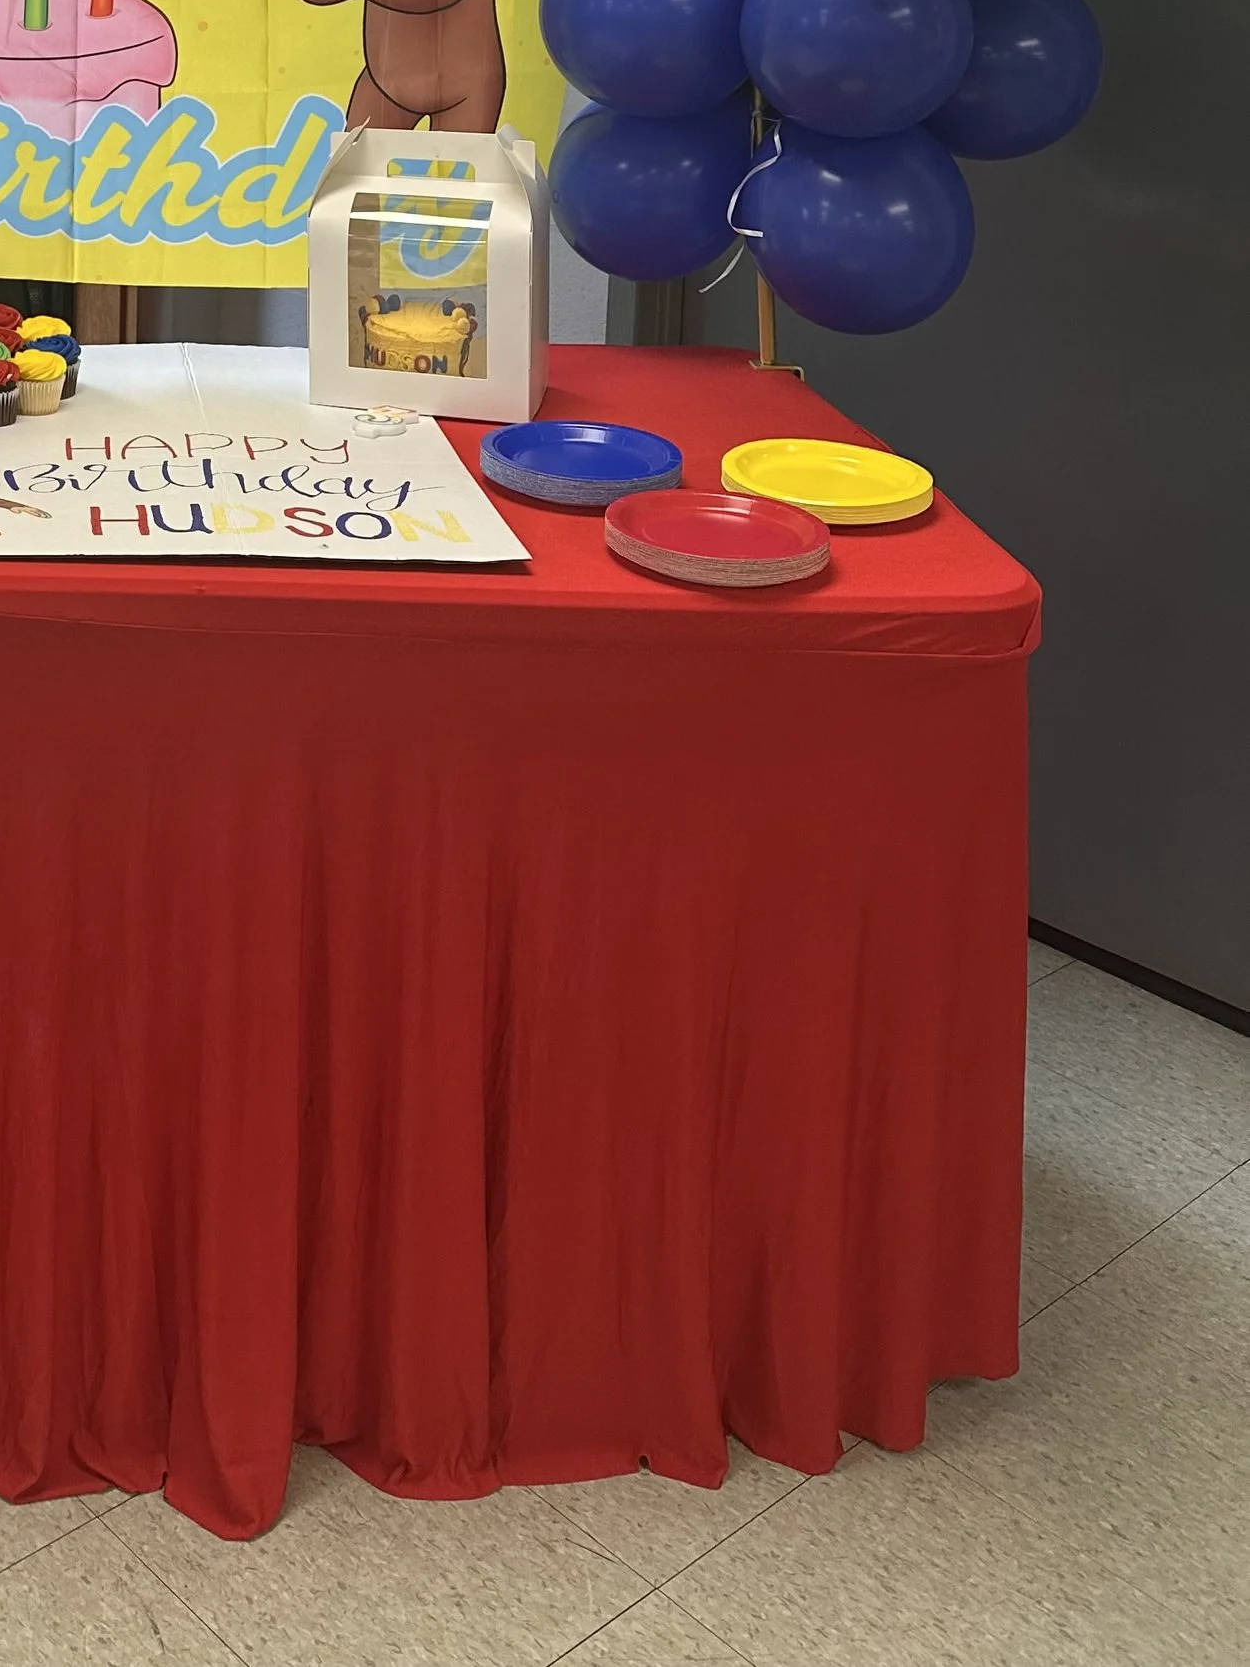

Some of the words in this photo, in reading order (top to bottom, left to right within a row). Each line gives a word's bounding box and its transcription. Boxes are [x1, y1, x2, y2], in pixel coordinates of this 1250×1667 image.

[364, 341, 449, 375] HUDSON
[64, 432, 350, 465] HAPPY
[3, 458, 447, 511] Birthday
[90, 502, 473, 543] HUDSON
